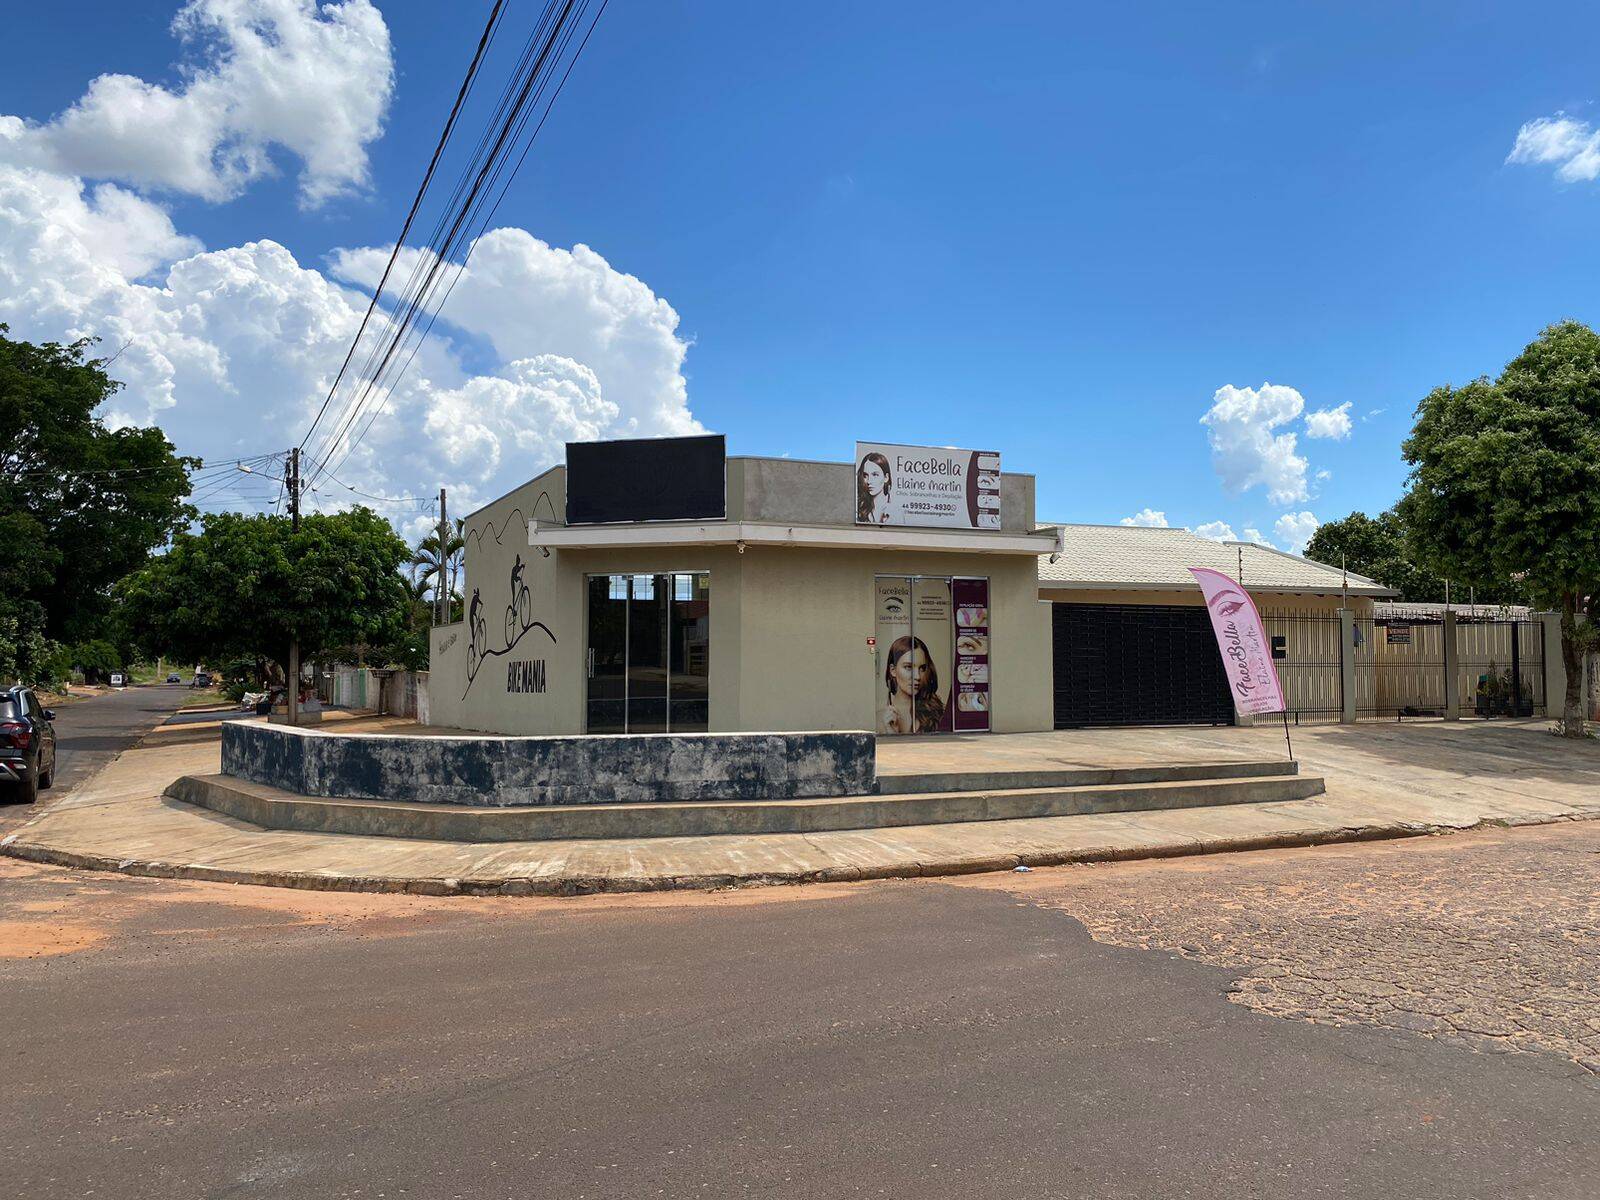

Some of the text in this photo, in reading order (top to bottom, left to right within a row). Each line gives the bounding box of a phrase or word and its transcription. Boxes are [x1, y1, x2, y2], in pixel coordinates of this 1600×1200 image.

[896, 456, 962, 476] FaceBella
[897, 477, 926, 490] Elaine
[910, 502, 951, 511] 99923-4930
[1225, 620, 1257, 698] FaceBella
[507, 660, 546, 693] BIKE MANIA
